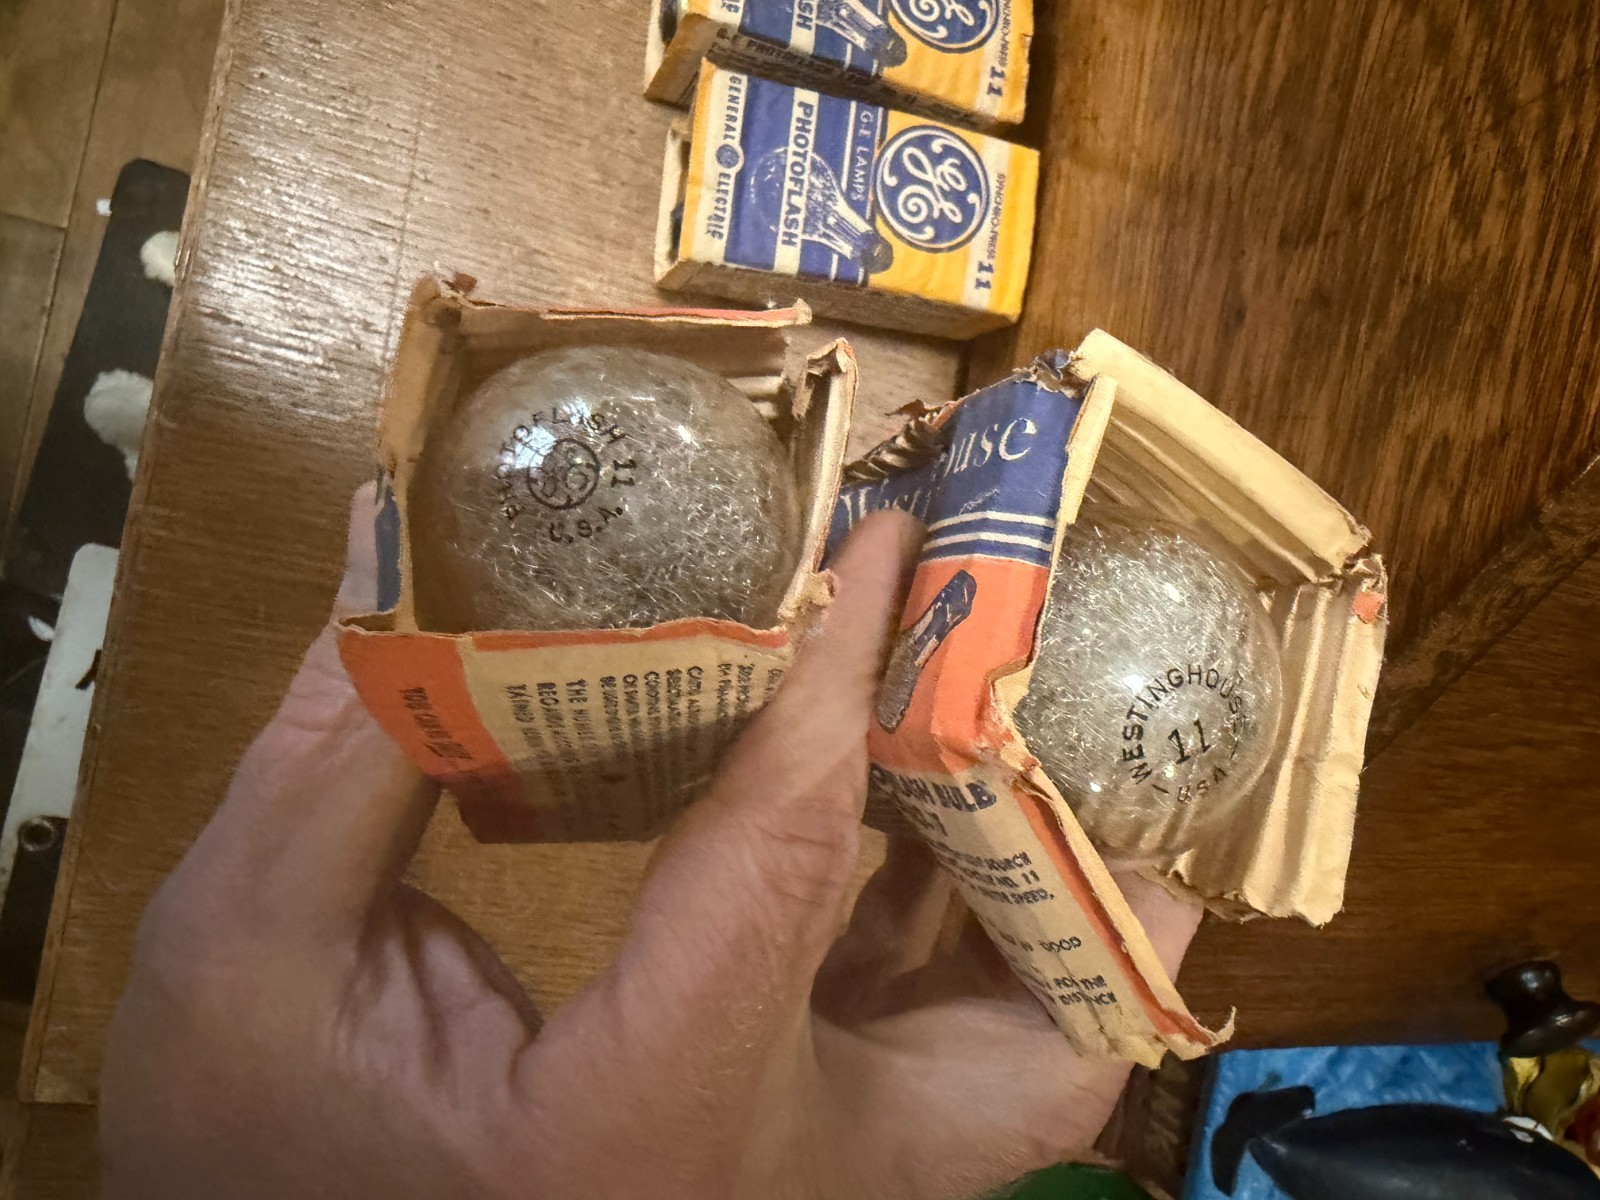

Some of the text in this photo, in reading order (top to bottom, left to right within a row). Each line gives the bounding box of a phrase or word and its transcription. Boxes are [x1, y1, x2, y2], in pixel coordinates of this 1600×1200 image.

[986, 65, 1006, 97] 11
[721, 74, 743, 145] GENERAL
[780, 101, 815, 248] PHOTOFLASH
[851, 140, 871, 202] LAMPS
[975, 261, 994, 290] 11
[610, 458, 637, 488] 11
[1167, 717, 1211, 765] 11
